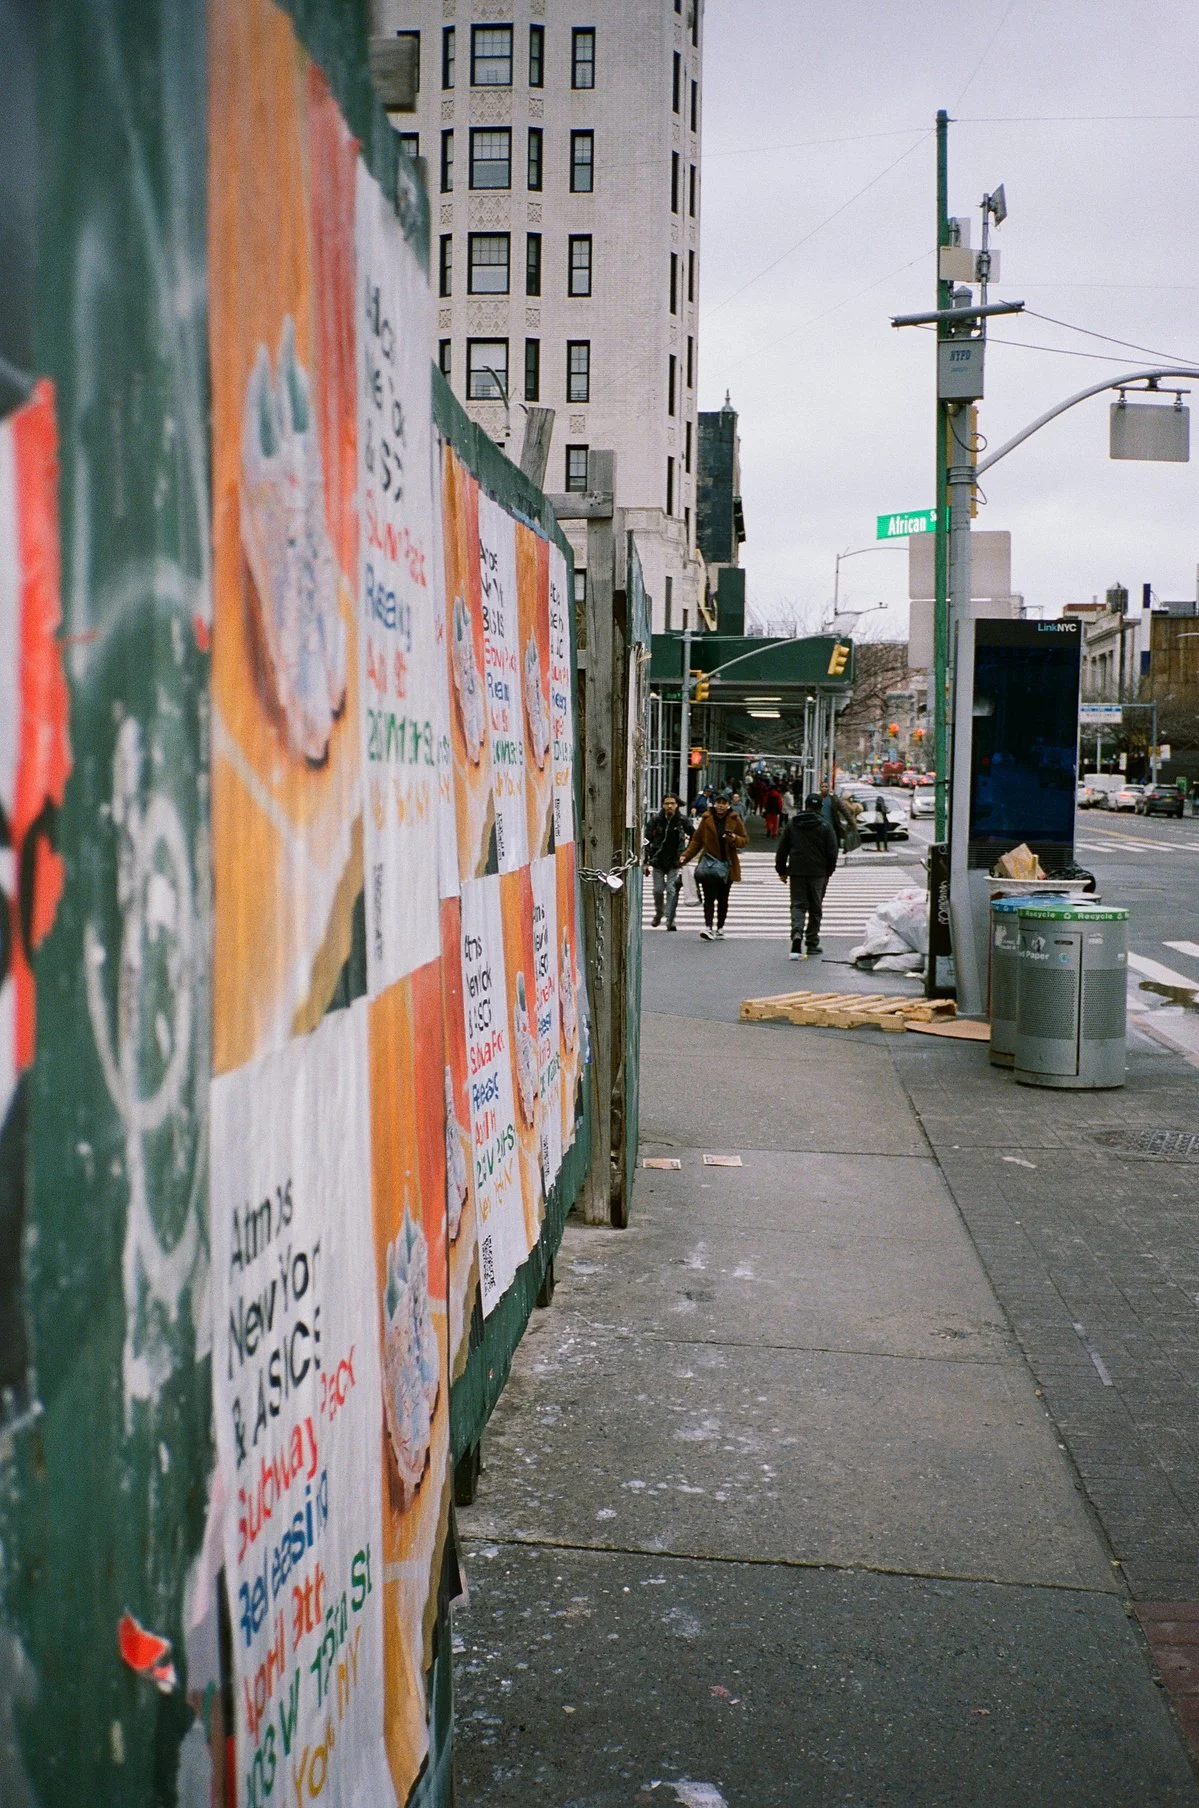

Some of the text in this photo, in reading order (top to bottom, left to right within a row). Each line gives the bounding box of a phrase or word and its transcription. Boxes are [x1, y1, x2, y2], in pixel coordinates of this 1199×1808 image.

[888, 515, 927, 536] African
[1037, 623, 1078, 633] LinkNYC
[1025, 911, 1113, 920] Recycle Recycle
[1026, 951, 1050, 961] Paper
